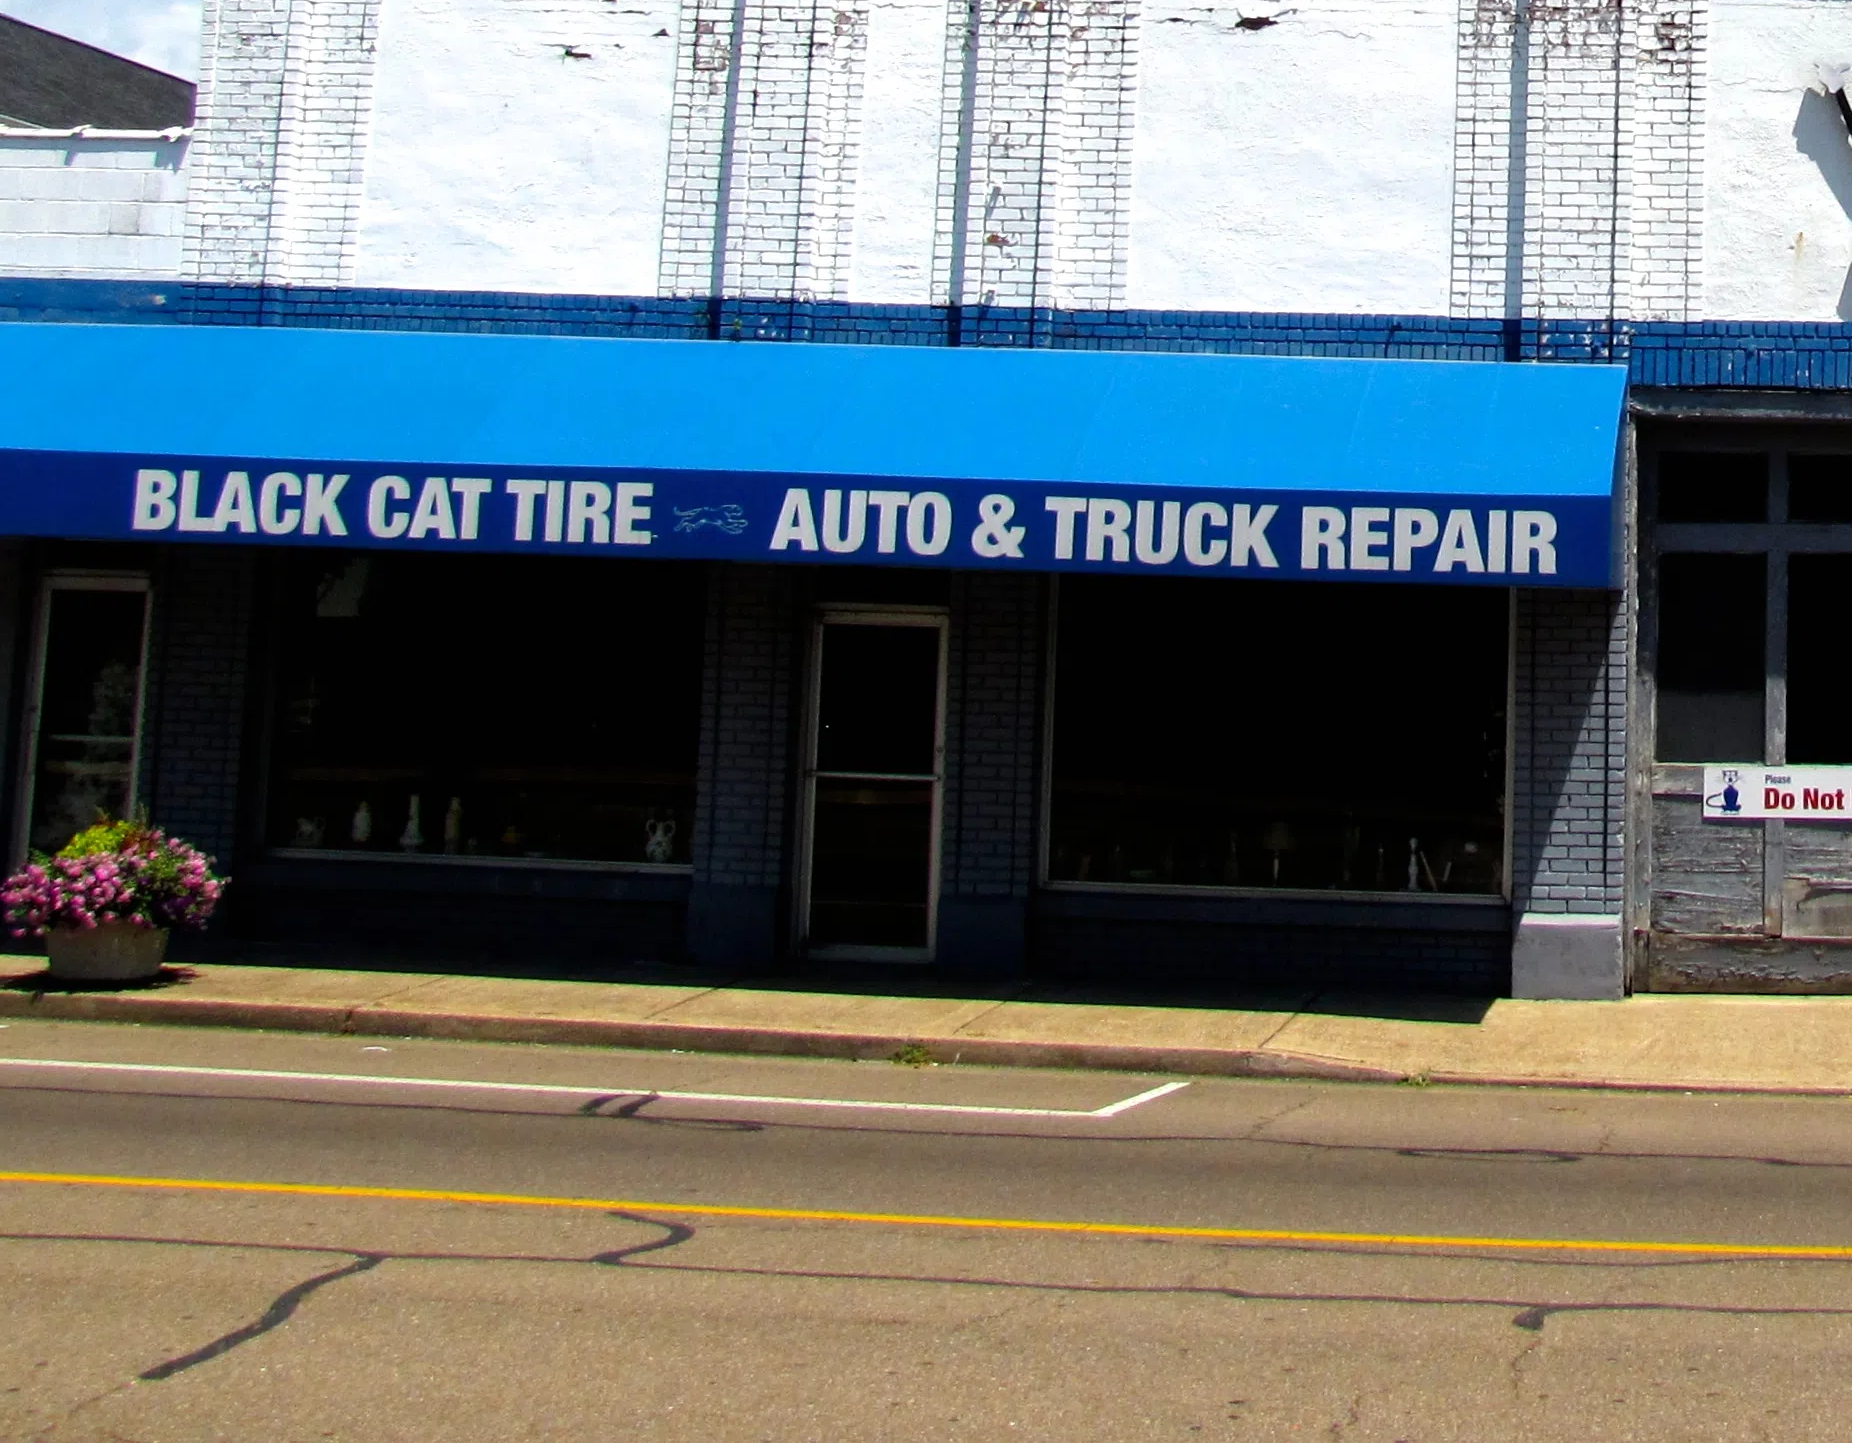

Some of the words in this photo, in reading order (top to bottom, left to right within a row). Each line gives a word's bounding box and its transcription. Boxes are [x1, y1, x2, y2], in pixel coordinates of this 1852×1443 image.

[131, 468, 351, 536] BLACK
[367, 475, 492, 541] CAT
[506, 477, 654, 545] TIRE
[769, 487, 952, 556] AUTO
[971, 494, 1026, 558] &
[1045, 495, 1280, 569] TRUCK
[1299, 505, 1558, 575] REPAIR
[1764, 774, 1792, 784] Please
[1763, 787, 1796, 810] Do
[1802, 787, 1845, 811] Not
